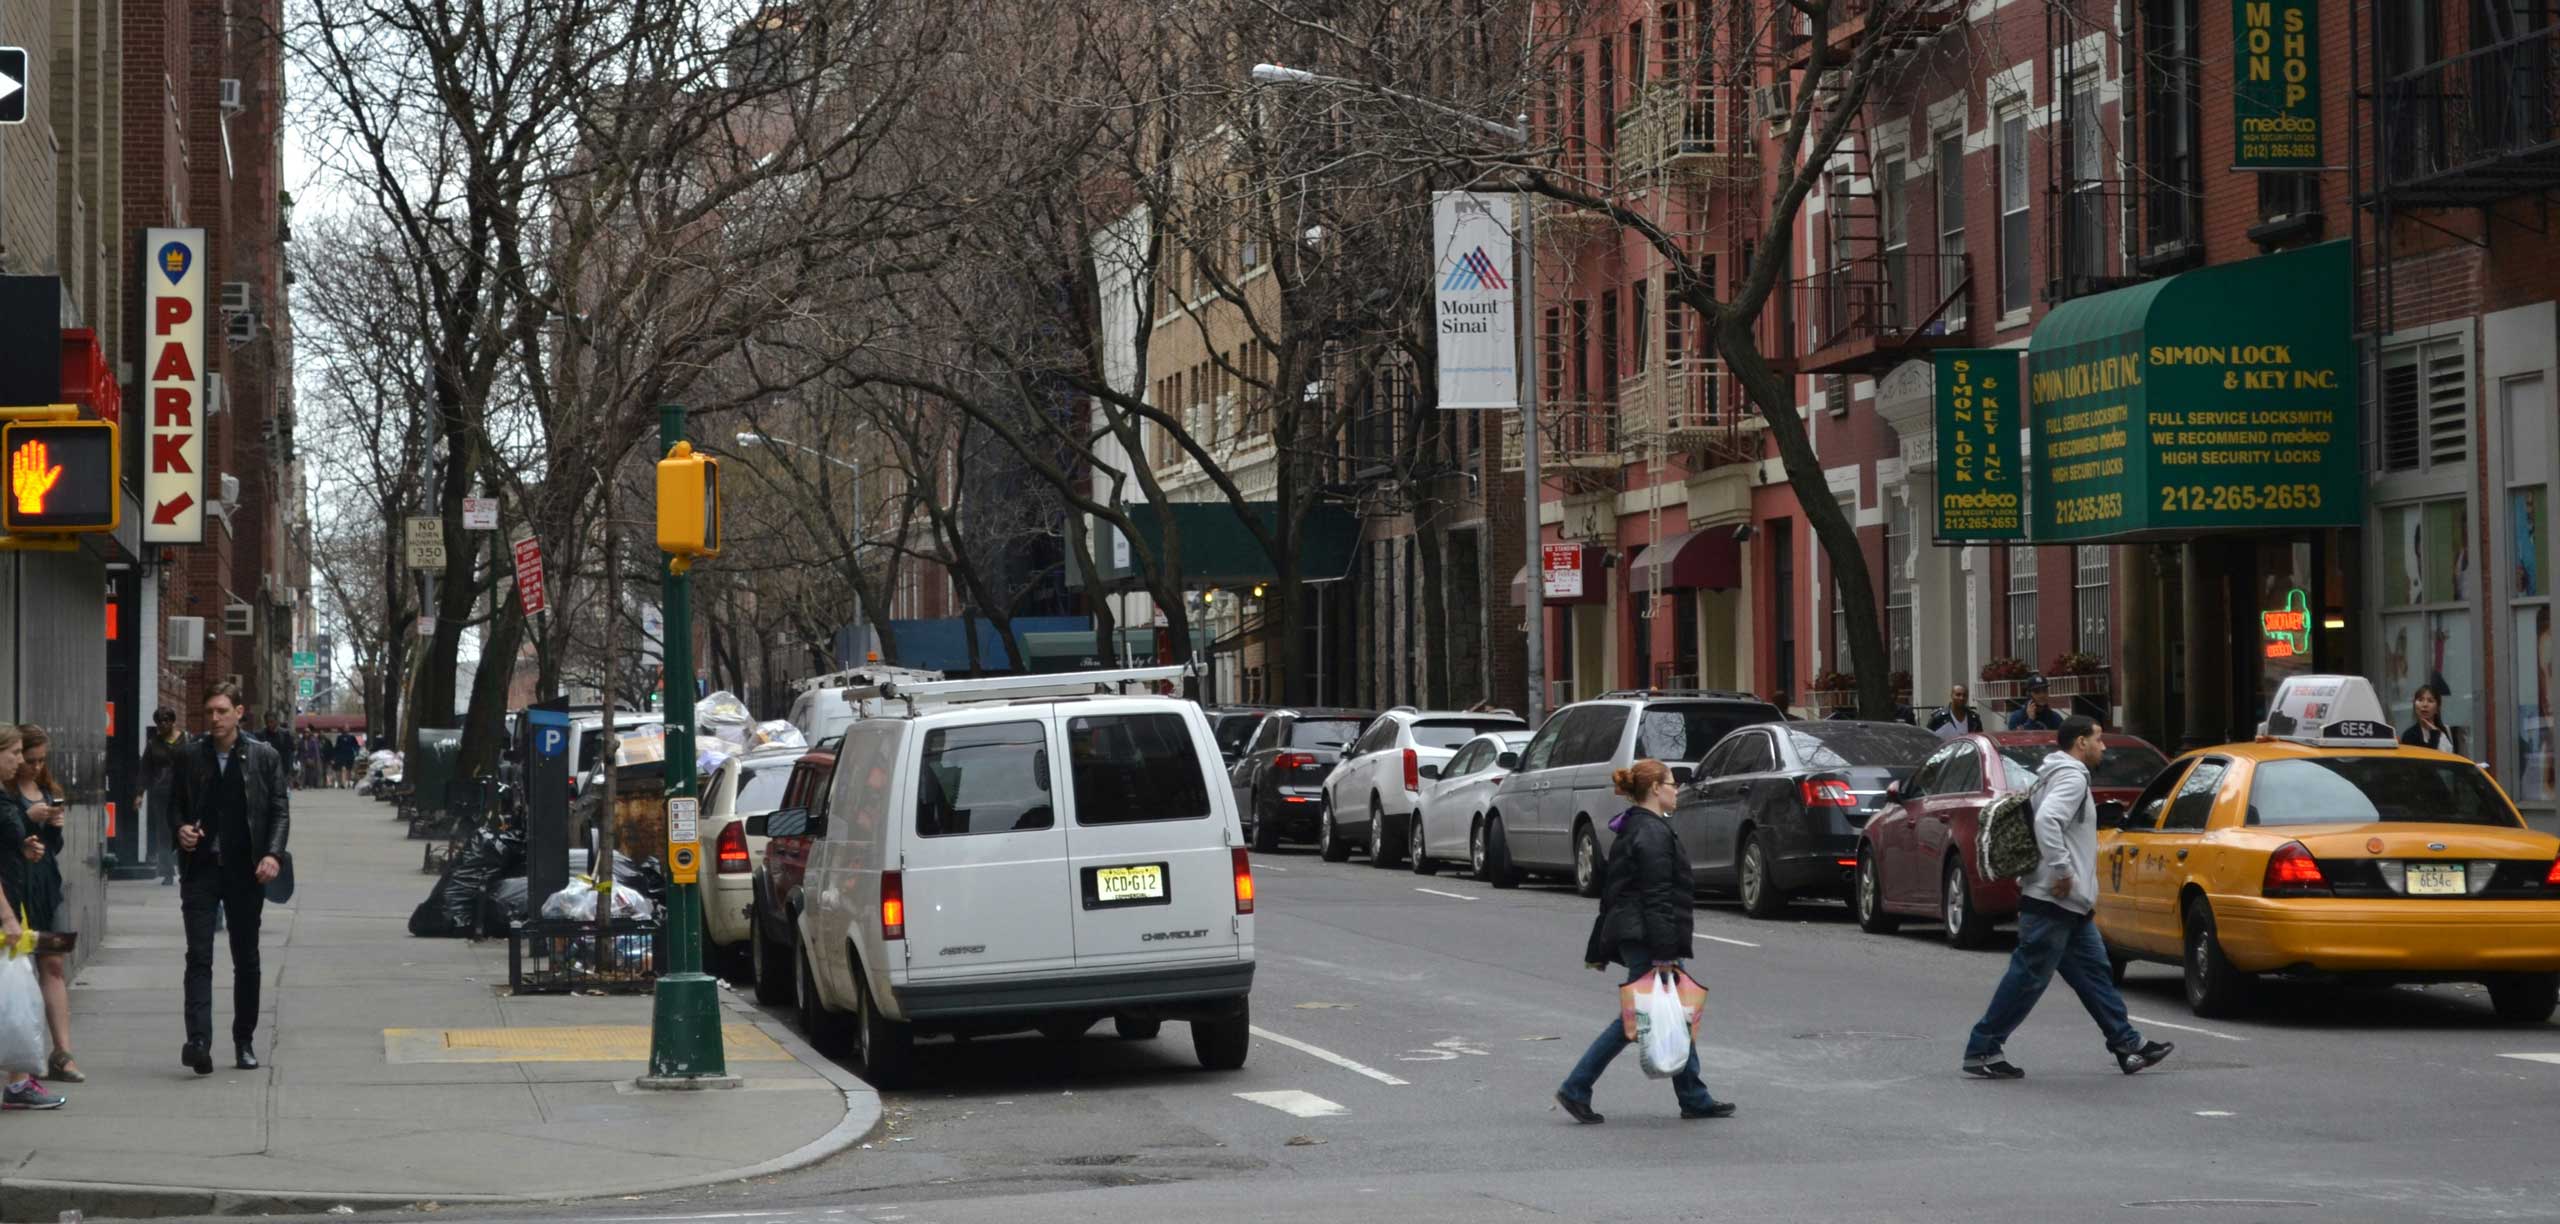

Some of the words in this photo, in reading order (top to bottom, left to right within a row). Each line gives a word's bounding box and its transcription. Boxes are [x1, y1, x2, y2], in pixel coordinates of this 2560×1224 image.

[2283, 8, 2306, 108] SHOP
[2242, 111, 2316, 133] medeco
[2243, 143, 2268, 160] (212)
[2271, 143, 2316, 158] 265-2653
[1441, 300, 1498, 315] Mount
[1441, 317, 1487, 333] Sinai
[2150, 346, 2225, 366] SIMON
[2231, 345, 2291, 365] LOCK
[151, 295, 195, 474] PARK
[1982, 377, 1998, 389] &
[2033, 369, 2063, 405] SIMON
[2064, 363, 2091, 399] LOCK
[2092, 361, 2099, 393] &
[2100, 357, 2119, 392] KEY
[2223, 371, 2240, 390] &
[2244, 370, 2288, 389] KEY
[2294, 370, 2339, 390] INC.
[1952, 360, 1973, 422] SIMON
[1982, 397, 1999, 434] KEY
[2149, 412, 2184, 426] FULL
[2188, 411, 2247, 425] SERVICE
[2251, 411, 2333, 425] LOCKSMITH
[2152, 431, 2175, 445] WE
[2178, 431, 2267, 444] RECOMMEND
[2272, 428, 2331, 443] medeco
[1955, 430, 1974, 482] LOCK
[2161, 451, 2198, 465] HIGH
[2201, 450, 2271, 464] SECURITY
[2275, 450, 2321, 463] LOCKS
[2102, 457, 2123, 476] LOCKS
[1944, 488, 2017, 508] medeco
[2161, 484, 2322, 512] 212-265-2653
[2055, 492, 2122, 525] 212-265-2653
[418, 520, 436, 531] NO
[1945, 517, 2017, 529] 212-265-2653
[2340, 721, 2374, 737] 6E54
[545, 729, 561, 752] P
[1141, 929, 1209, 942] CHEVROLET
